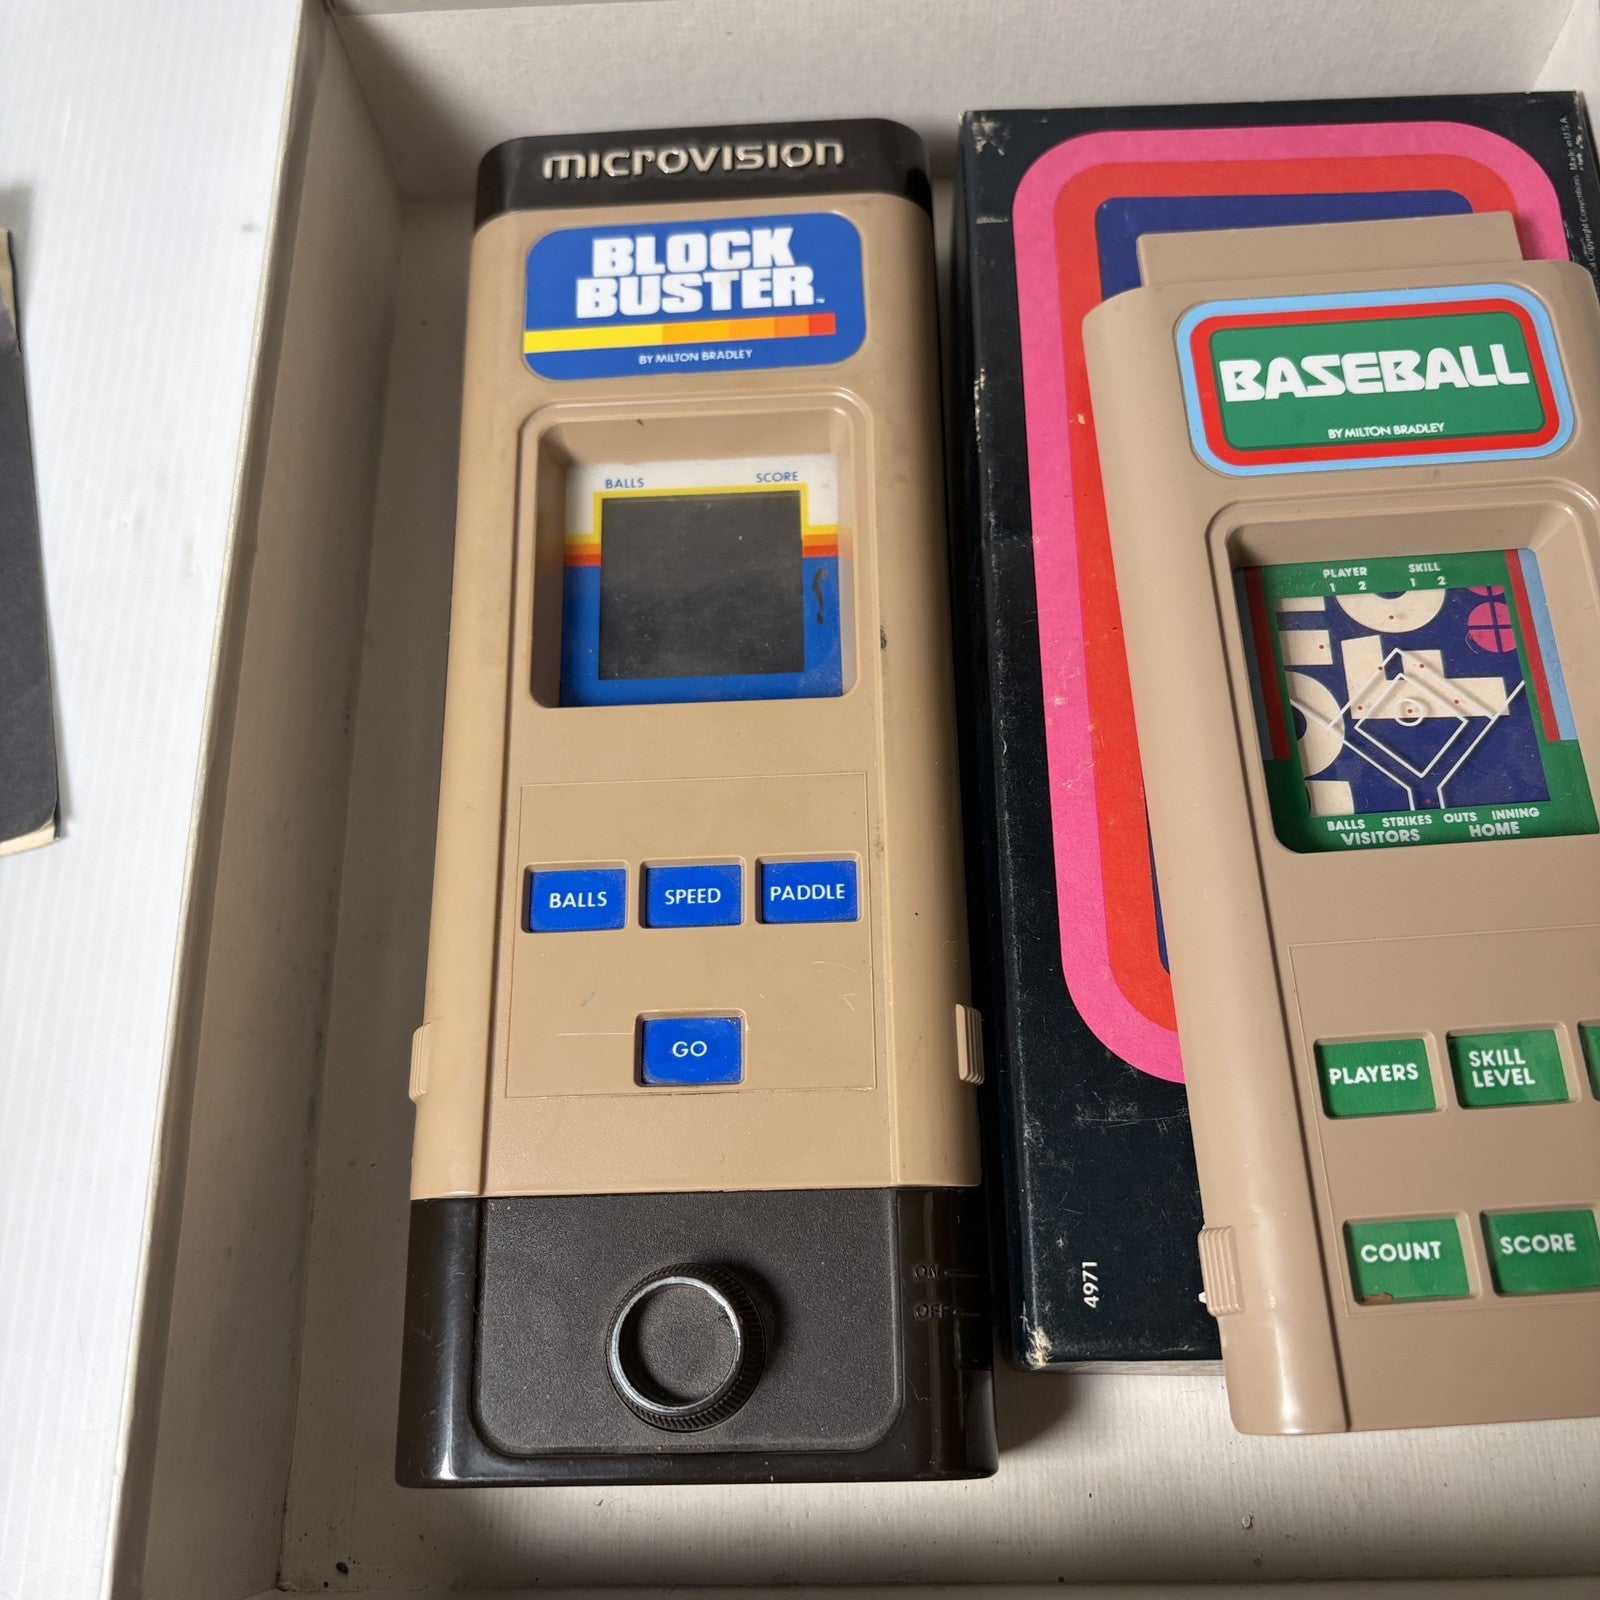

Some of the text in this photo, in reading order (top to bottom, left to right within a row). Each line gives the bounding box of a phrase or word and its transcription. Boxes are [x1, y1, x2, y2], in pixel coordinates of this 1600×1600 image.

[1568, 149, 1579, 171] Made
[592, 227, 794, 278] BLOCK
[638, 349, 753, 365] BY MILTON BRADLEY
[1219, 343, 1530, 403] BASEBALL
[1327, 422, 1445, 440] BY MILTON BRADLEY
[605, 471, 799, 489] BALLS SCORE
[1323, 562, 1441, 578] PLAYER SKILL
[1329, 576, 1447, 592] 1 2 1 2
[1327, 807, 1540, 831] BALLS STRIKES OUTS INNING
[1340, 821, 1521, 846] VISITORS HOME
[549, 891, 607, 909] BALLS
[665, 887, 722, 905] SPEED
[770, 883, 846, 902] PADDLE
[672, 1040, 708, 1057] GO
[1468, 1048, 1526, 1066] SKILL
[1328, 1063, 1419, 1086] PLAYERS
[1472, 1067, 1535, 1088] LEVEL
[1360, 1241, 1442, 1264] COUNT
[1500, 1233, 1576, 1254] SCORE
[912, 1264, 940, 1280] ON
[1081, 1261, 1100, 1309] 4971
[914, 1303, 950, 1320] OFF
